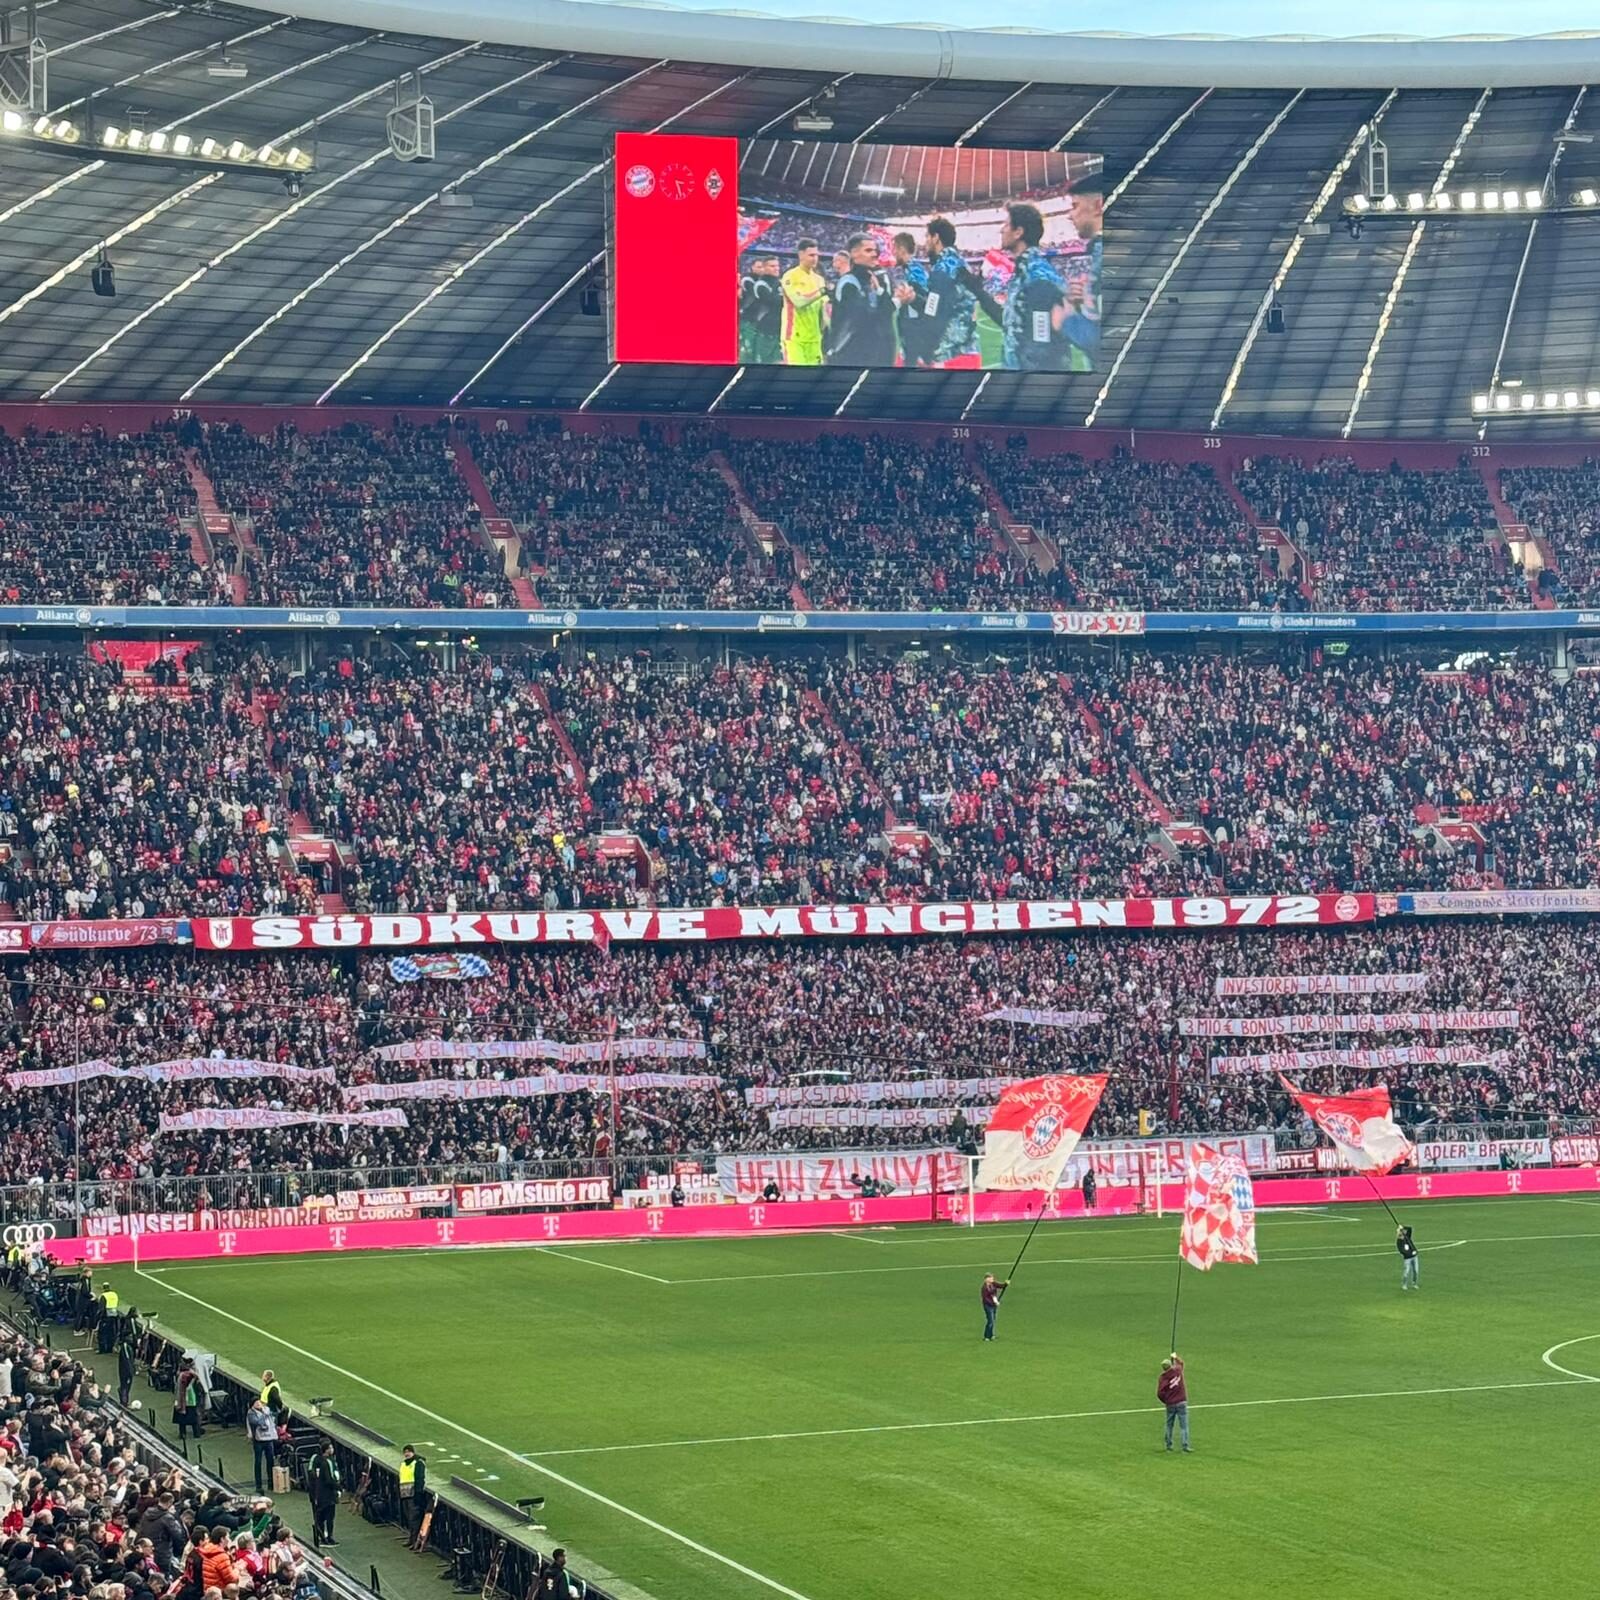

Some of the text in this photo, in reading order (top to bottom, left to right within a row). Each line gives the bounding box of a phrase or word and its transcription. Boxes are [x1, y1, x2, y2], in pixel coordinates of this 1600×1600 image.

[952, 428, 970, 439] 314
[1204, 438, 1221, 448] 313
[1472, 446, 1490, 456] 312
[36, 610, 74, 620] Allianz
[288, 612, 325, 622] Allianz
[528, 613, 562, 623] Allianz
[759, 615, 792, 626] Allianz
[981, 616, 1014, 626] Allianz
[1238, 617, 1356, 627] Allianz Global Investors
[1053, 614, 1109, 632] SUPS
[251, 912, 706, 949] SÜDKURVE
[739, 900, 1125, 936] MÜNCHEN
[1153, 896, 1320, 928] 1972
[53, 926, 131, 943] Südkurve
[1347, 975, 1368, 991] MIT
[1241, 1018, 1284, 1034] BONUS
[1436, 1011, 1512, 1028] FRANKREICH
[1216, 1056, 1262, 1072] WELCHE
[882, 1083, 913, 1097] GUT
[777, 1110, 870, 1126] SCHLECHT
[1423, 1144, 1467, 1159] ADLER
[1553, 1138, 1598, 1162] SELTERS
[735, 1159, 805, 1193] NEIN
[461, 1182, 576, 1208] alarMstufe
[578, 1180, 609, 1202] rot
[630, 1195, 653, 1207] RD
[326, 1207, 413, 1223] RED COBRAS
